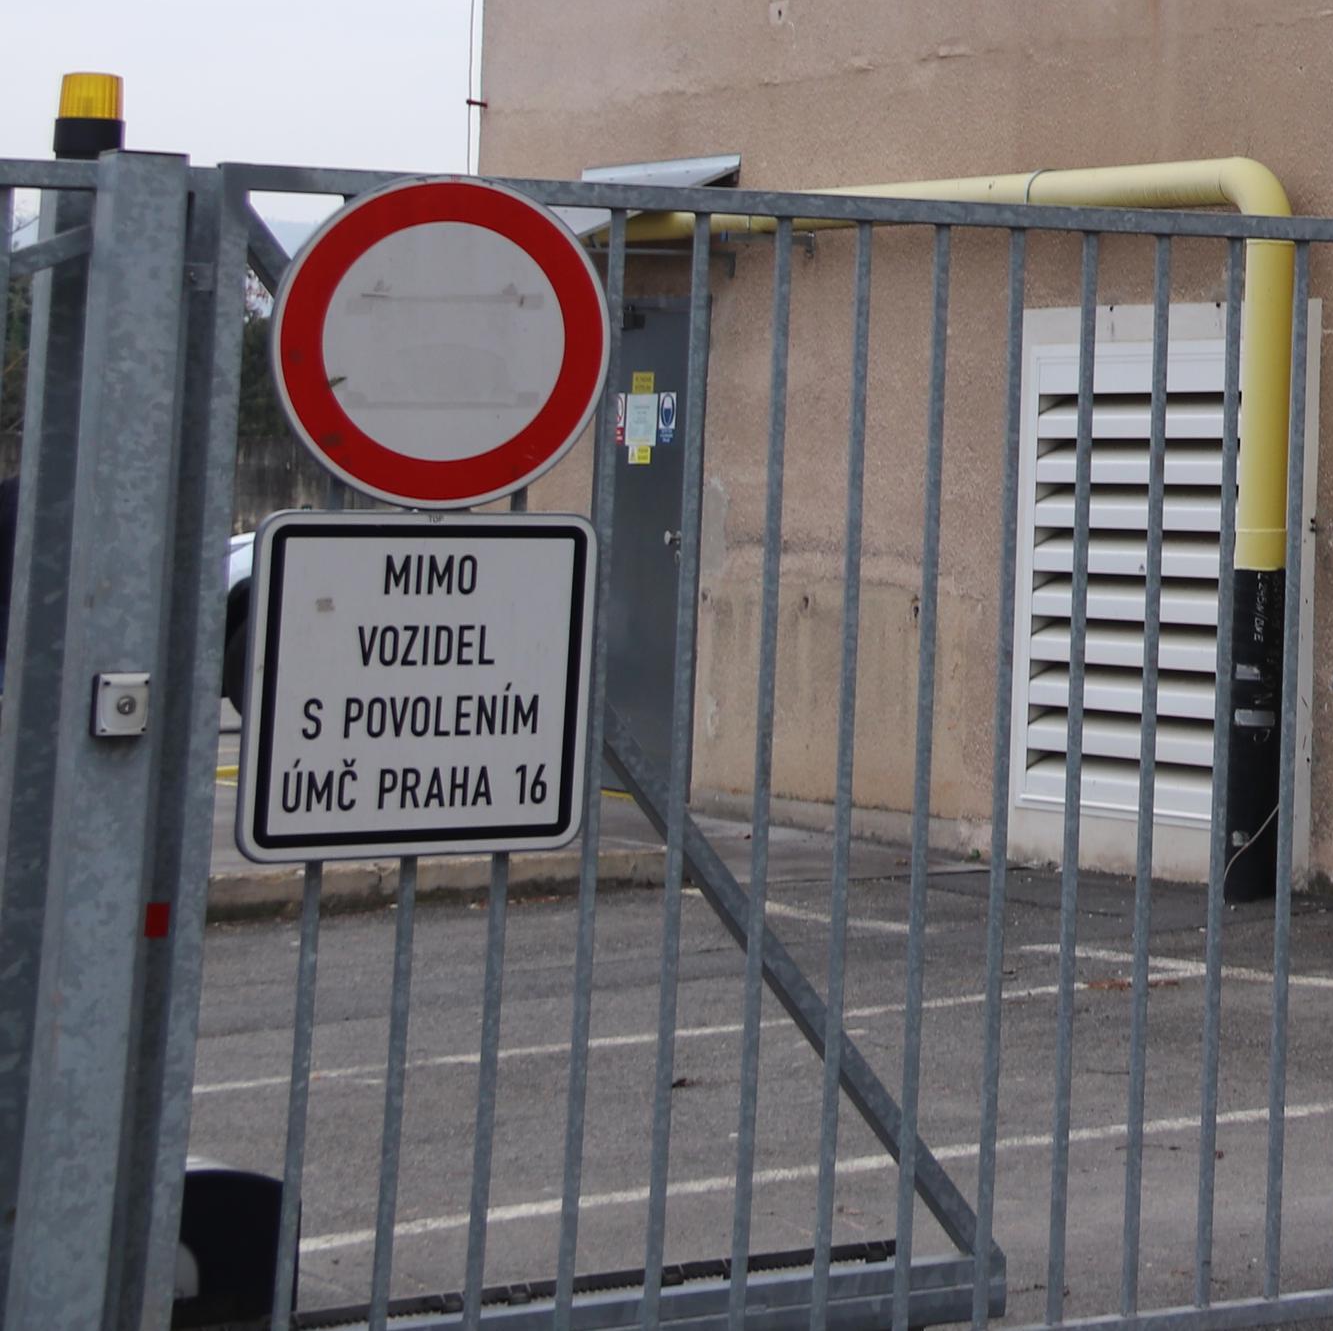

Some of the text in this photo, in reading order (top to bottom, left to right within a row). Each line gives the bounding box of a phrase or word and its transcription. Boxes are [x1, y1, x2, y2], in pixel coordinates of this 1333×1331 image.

[383, 554, 478, 597] MIMO
[357, 624, 495, 668] VOZIDEL
[301, 682, 541, 742] S POVOLENÍM
[281, 758, 549, 815] ÚMČ PRAHA 16
